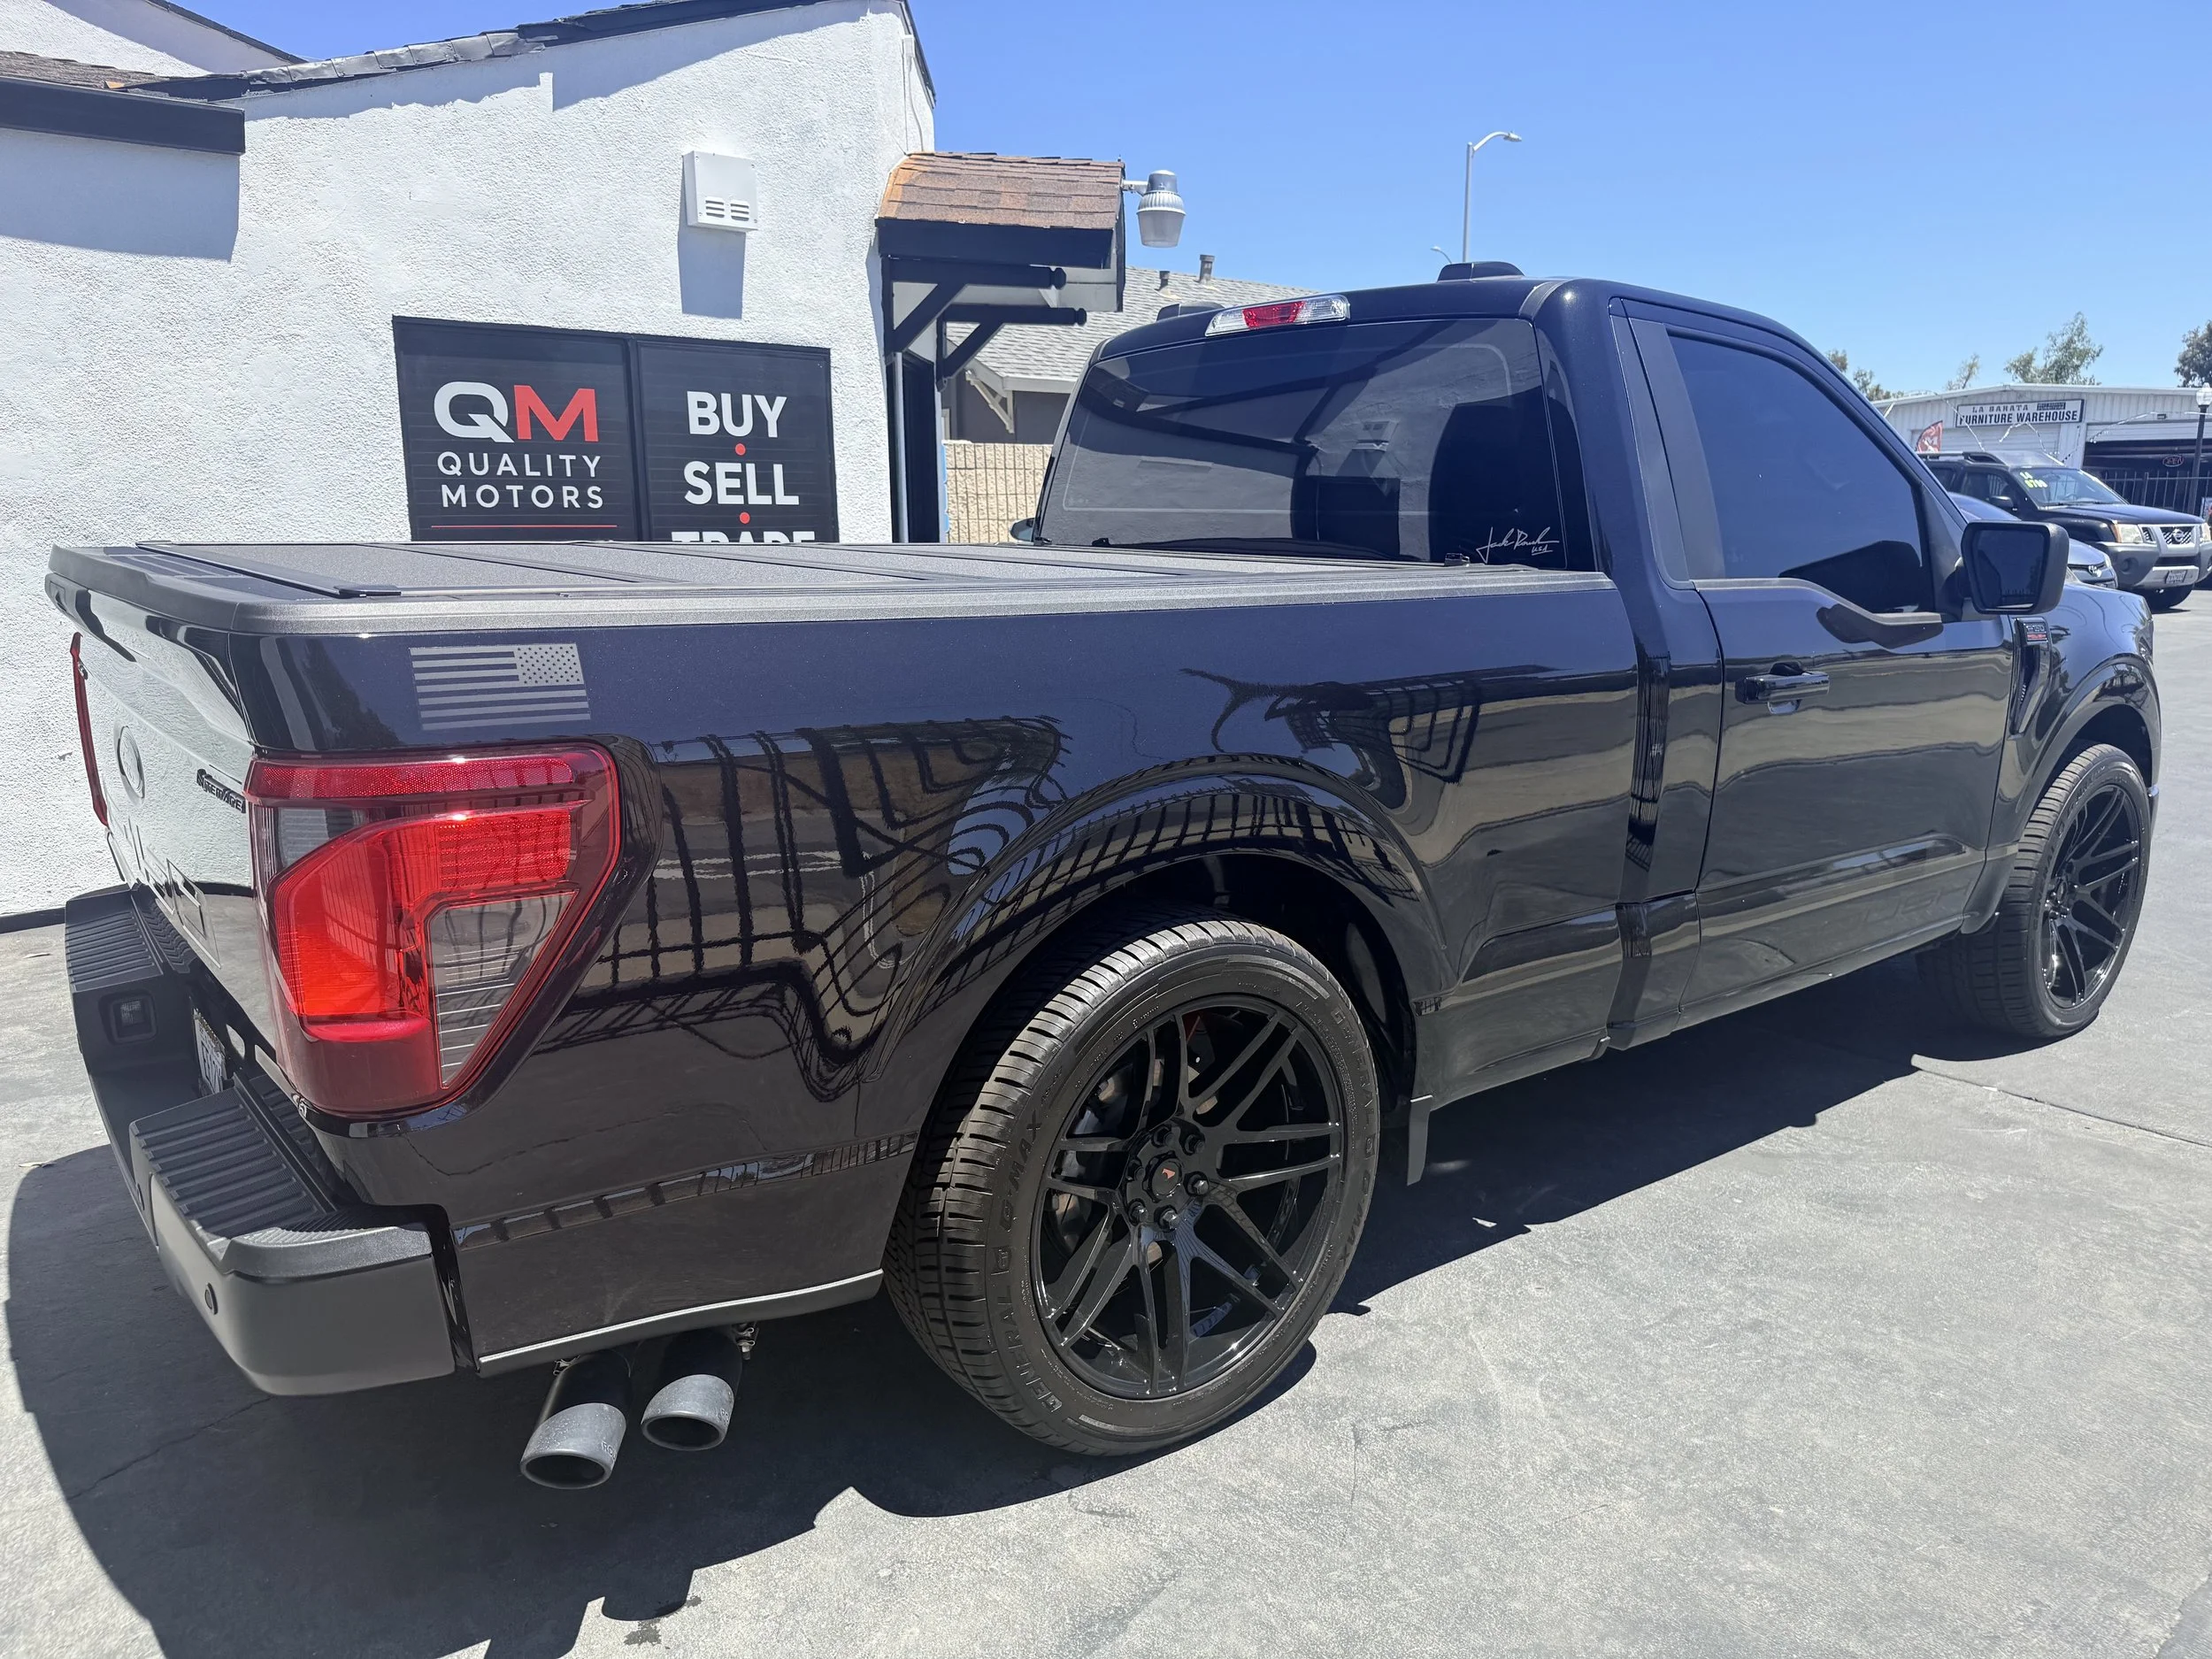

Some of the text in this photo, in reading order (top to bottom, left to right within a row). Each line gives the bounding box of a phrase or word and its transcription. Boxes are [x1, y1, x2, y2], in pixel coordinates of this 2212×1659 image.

[434, 381, 598, 442] QM
[687, 391, 787, 437] BUY
[1959, 411, 2078, 425] FURNITURE WAREHOUSE
[437, 451, 601, 478] QUALITY
[442, 485, 603, 509] MOTORS
[684, 461, 799, 505] SELL
